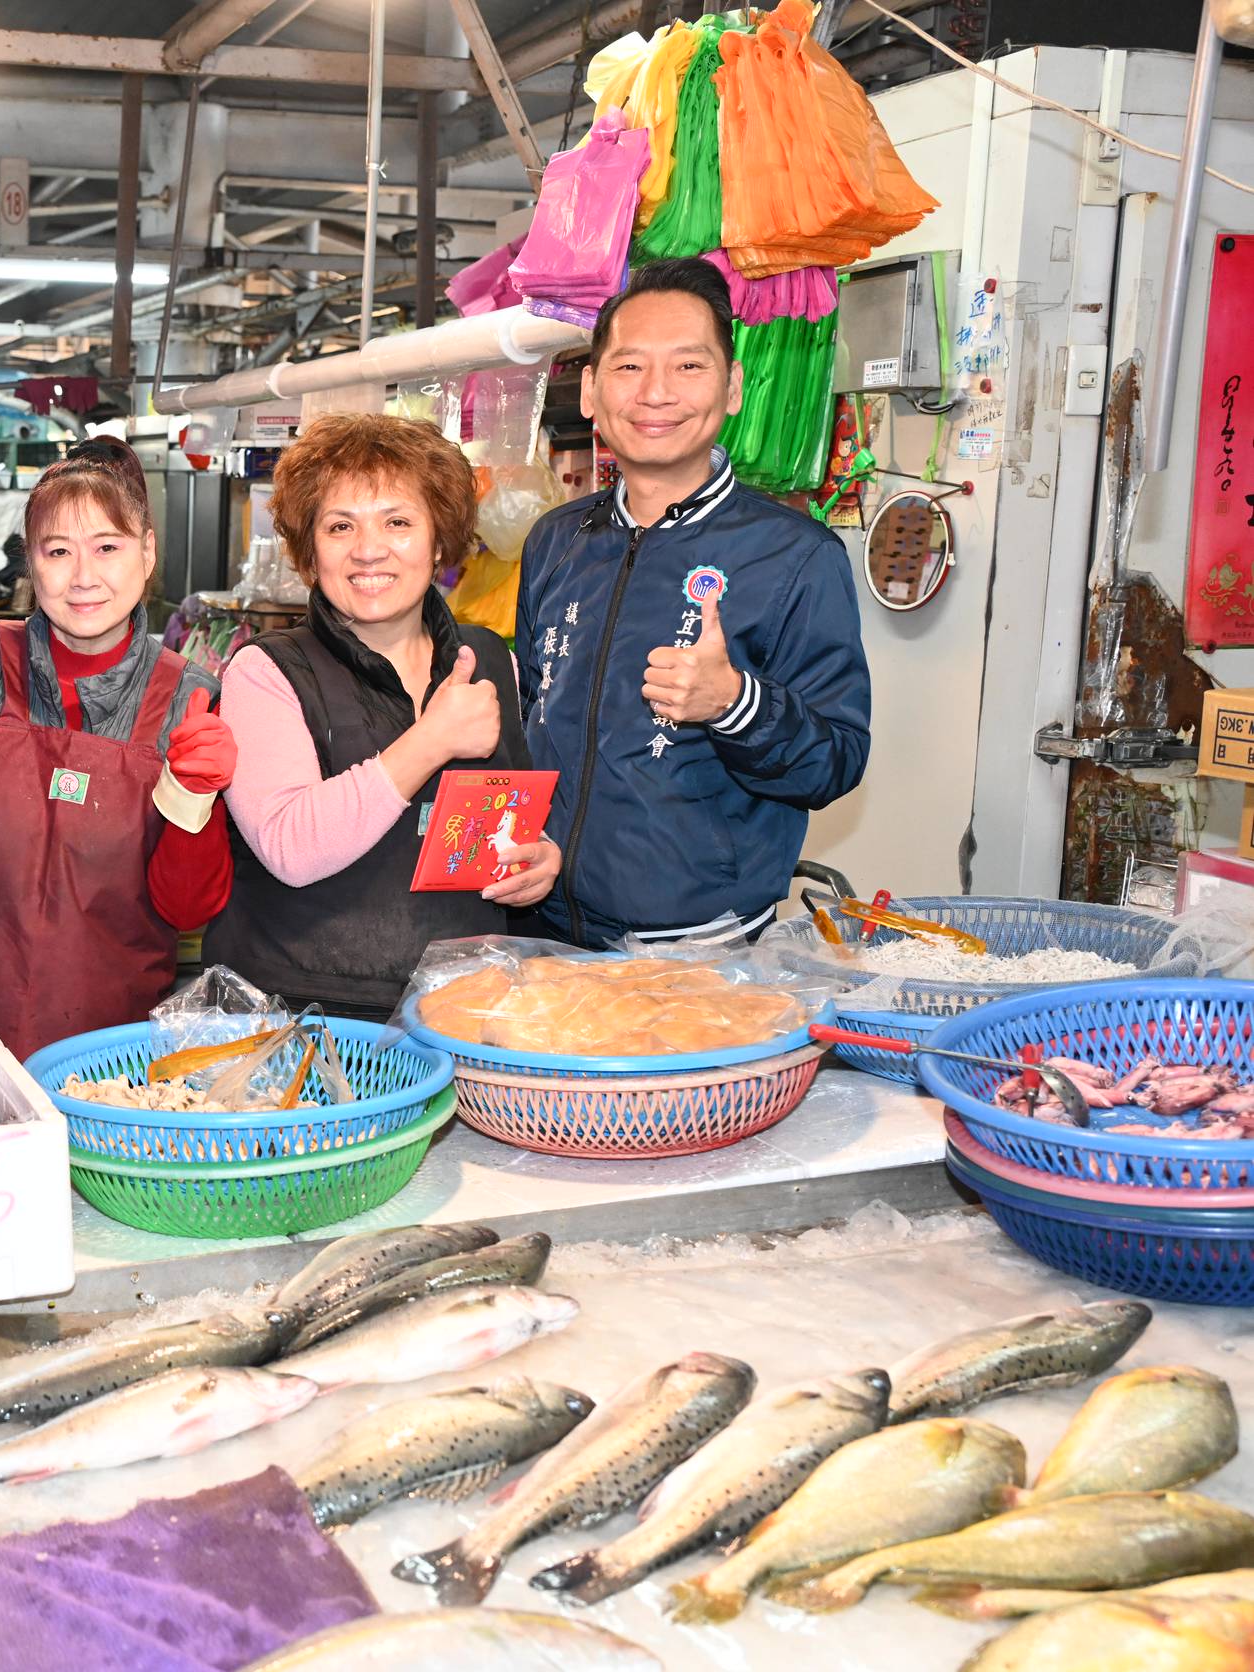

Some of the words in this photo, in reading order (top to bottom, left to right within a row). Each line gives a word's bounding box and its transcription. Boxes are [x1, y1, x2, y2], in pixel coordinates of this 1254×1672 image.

[6, 191, 22, 217] 18
[559, 601, 579, 657] 議長
[539, 626, 558, 724] 張勝
[481, 788, 531, 812] 2026
